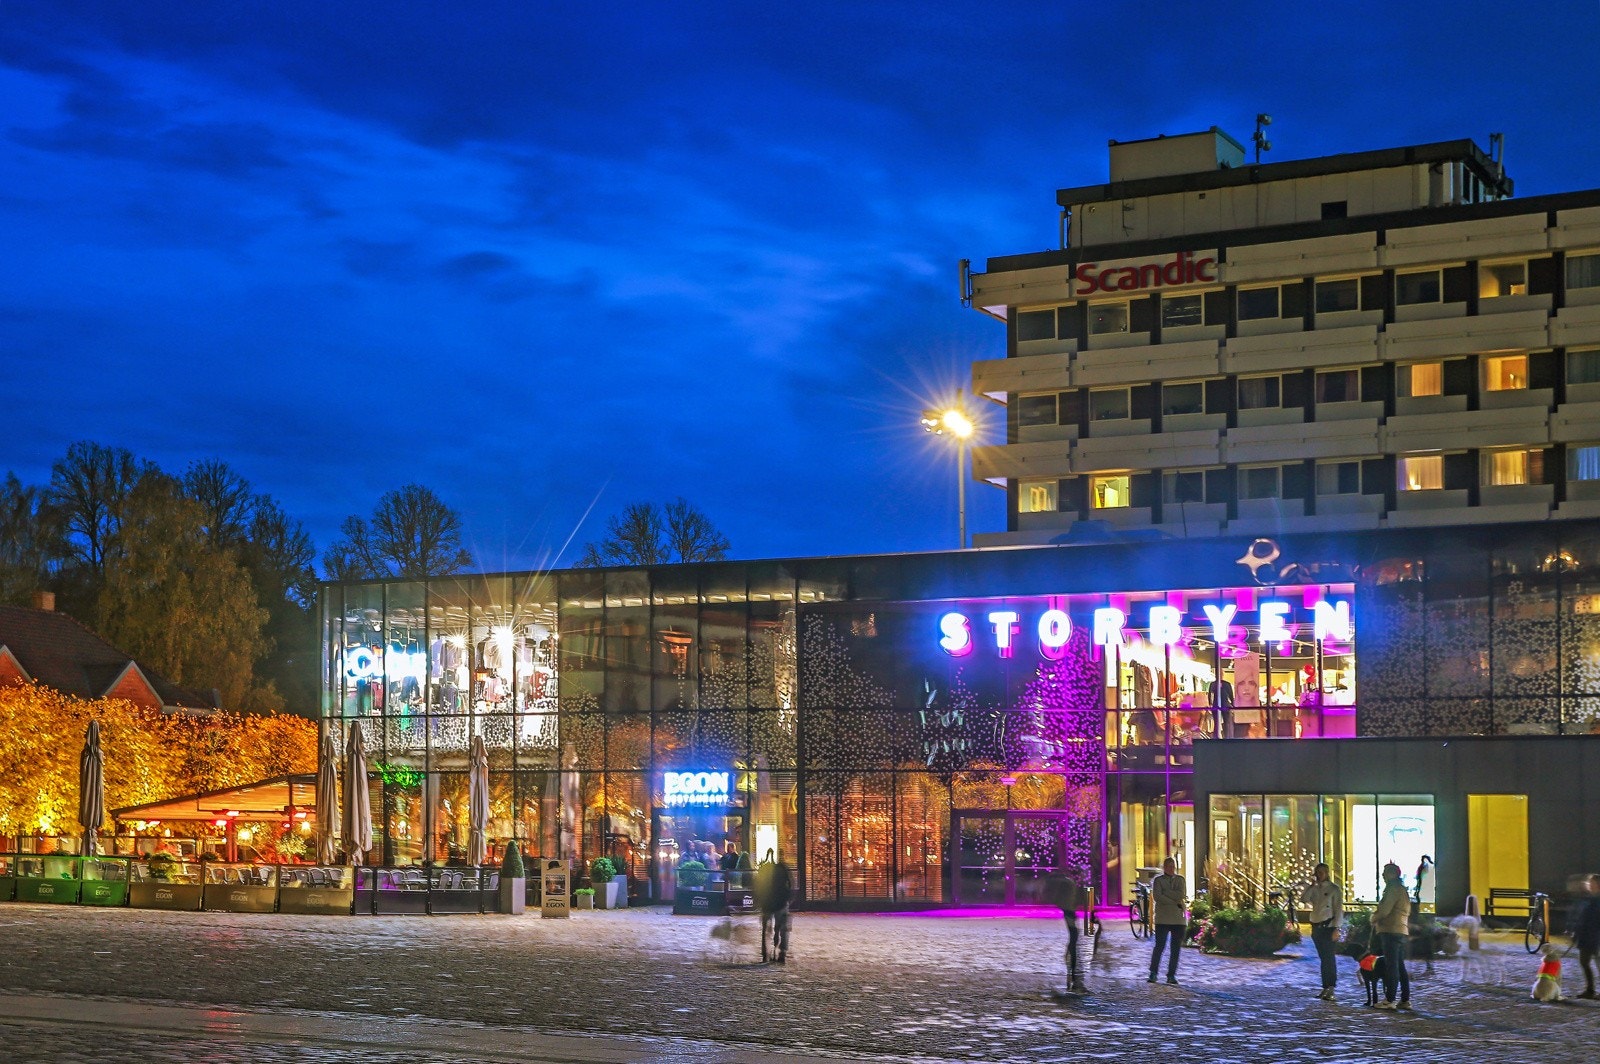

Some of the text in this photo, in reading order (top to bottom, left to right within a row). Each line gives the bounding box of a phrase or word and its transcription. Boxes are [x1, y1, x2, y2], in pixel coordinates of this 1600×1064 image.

[1076, 250, 1216, 295] Scandic
[939, 600, 1350, 652] STORBYEN
[664, 772, 729, 793] EGON
[155, 892, 173, 900] EGON
[231, 894, 248, 902] EGON
